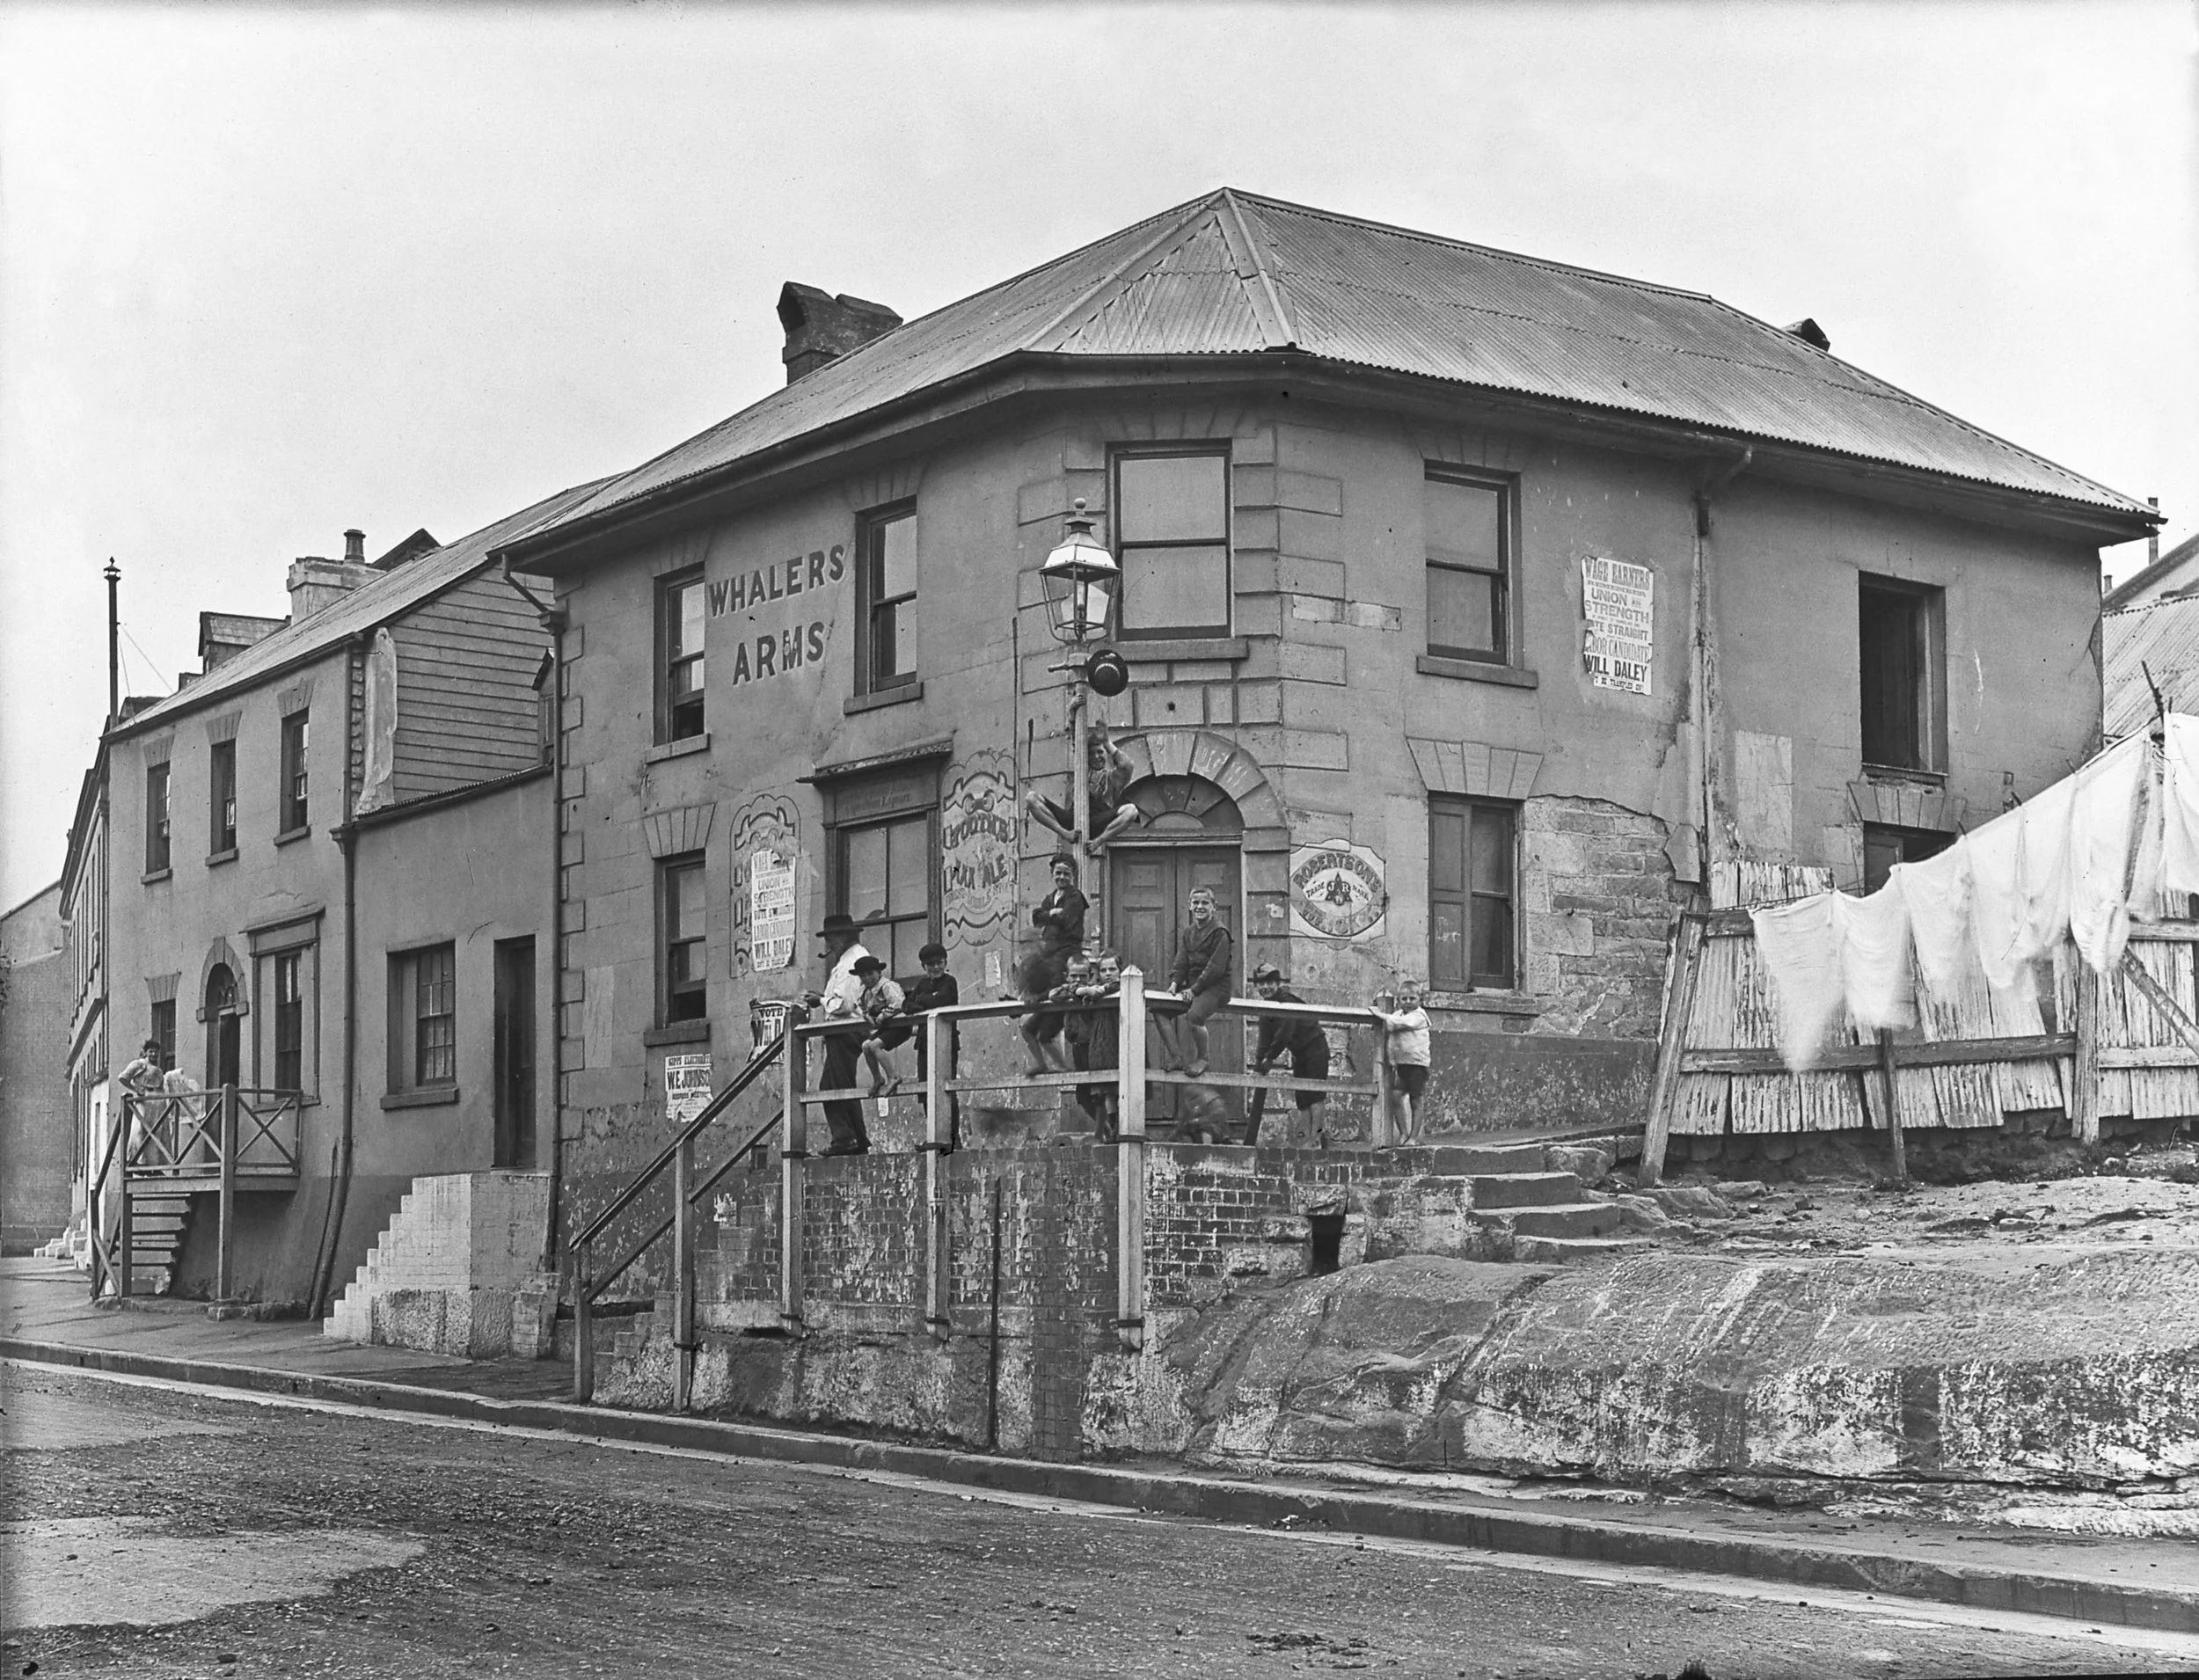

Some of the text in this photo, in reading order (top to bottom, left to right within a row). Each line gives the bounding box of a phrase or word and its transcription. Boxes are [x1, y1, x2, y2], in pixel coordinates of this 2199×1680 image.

[708, 544, 845, 617] WHALERS
[1611, 564, 1649, 591] EARNERS
[1591, 588, 1628, 607] UNION
[1585, 600, 1649, 625] STRENGTH
[1607, 623, 1648, 641] STRAIGHT
[732, 621, 825, 686] ARMS
[1608, 639, 1649, 664] CANDIDATE
[1583, 654, 1647, 683] WILL DALEY
[757, 878, 781, 892] UNION
[754, 940, 771, 960] WILL
[757, 1007, 784, 1019] VOTE
